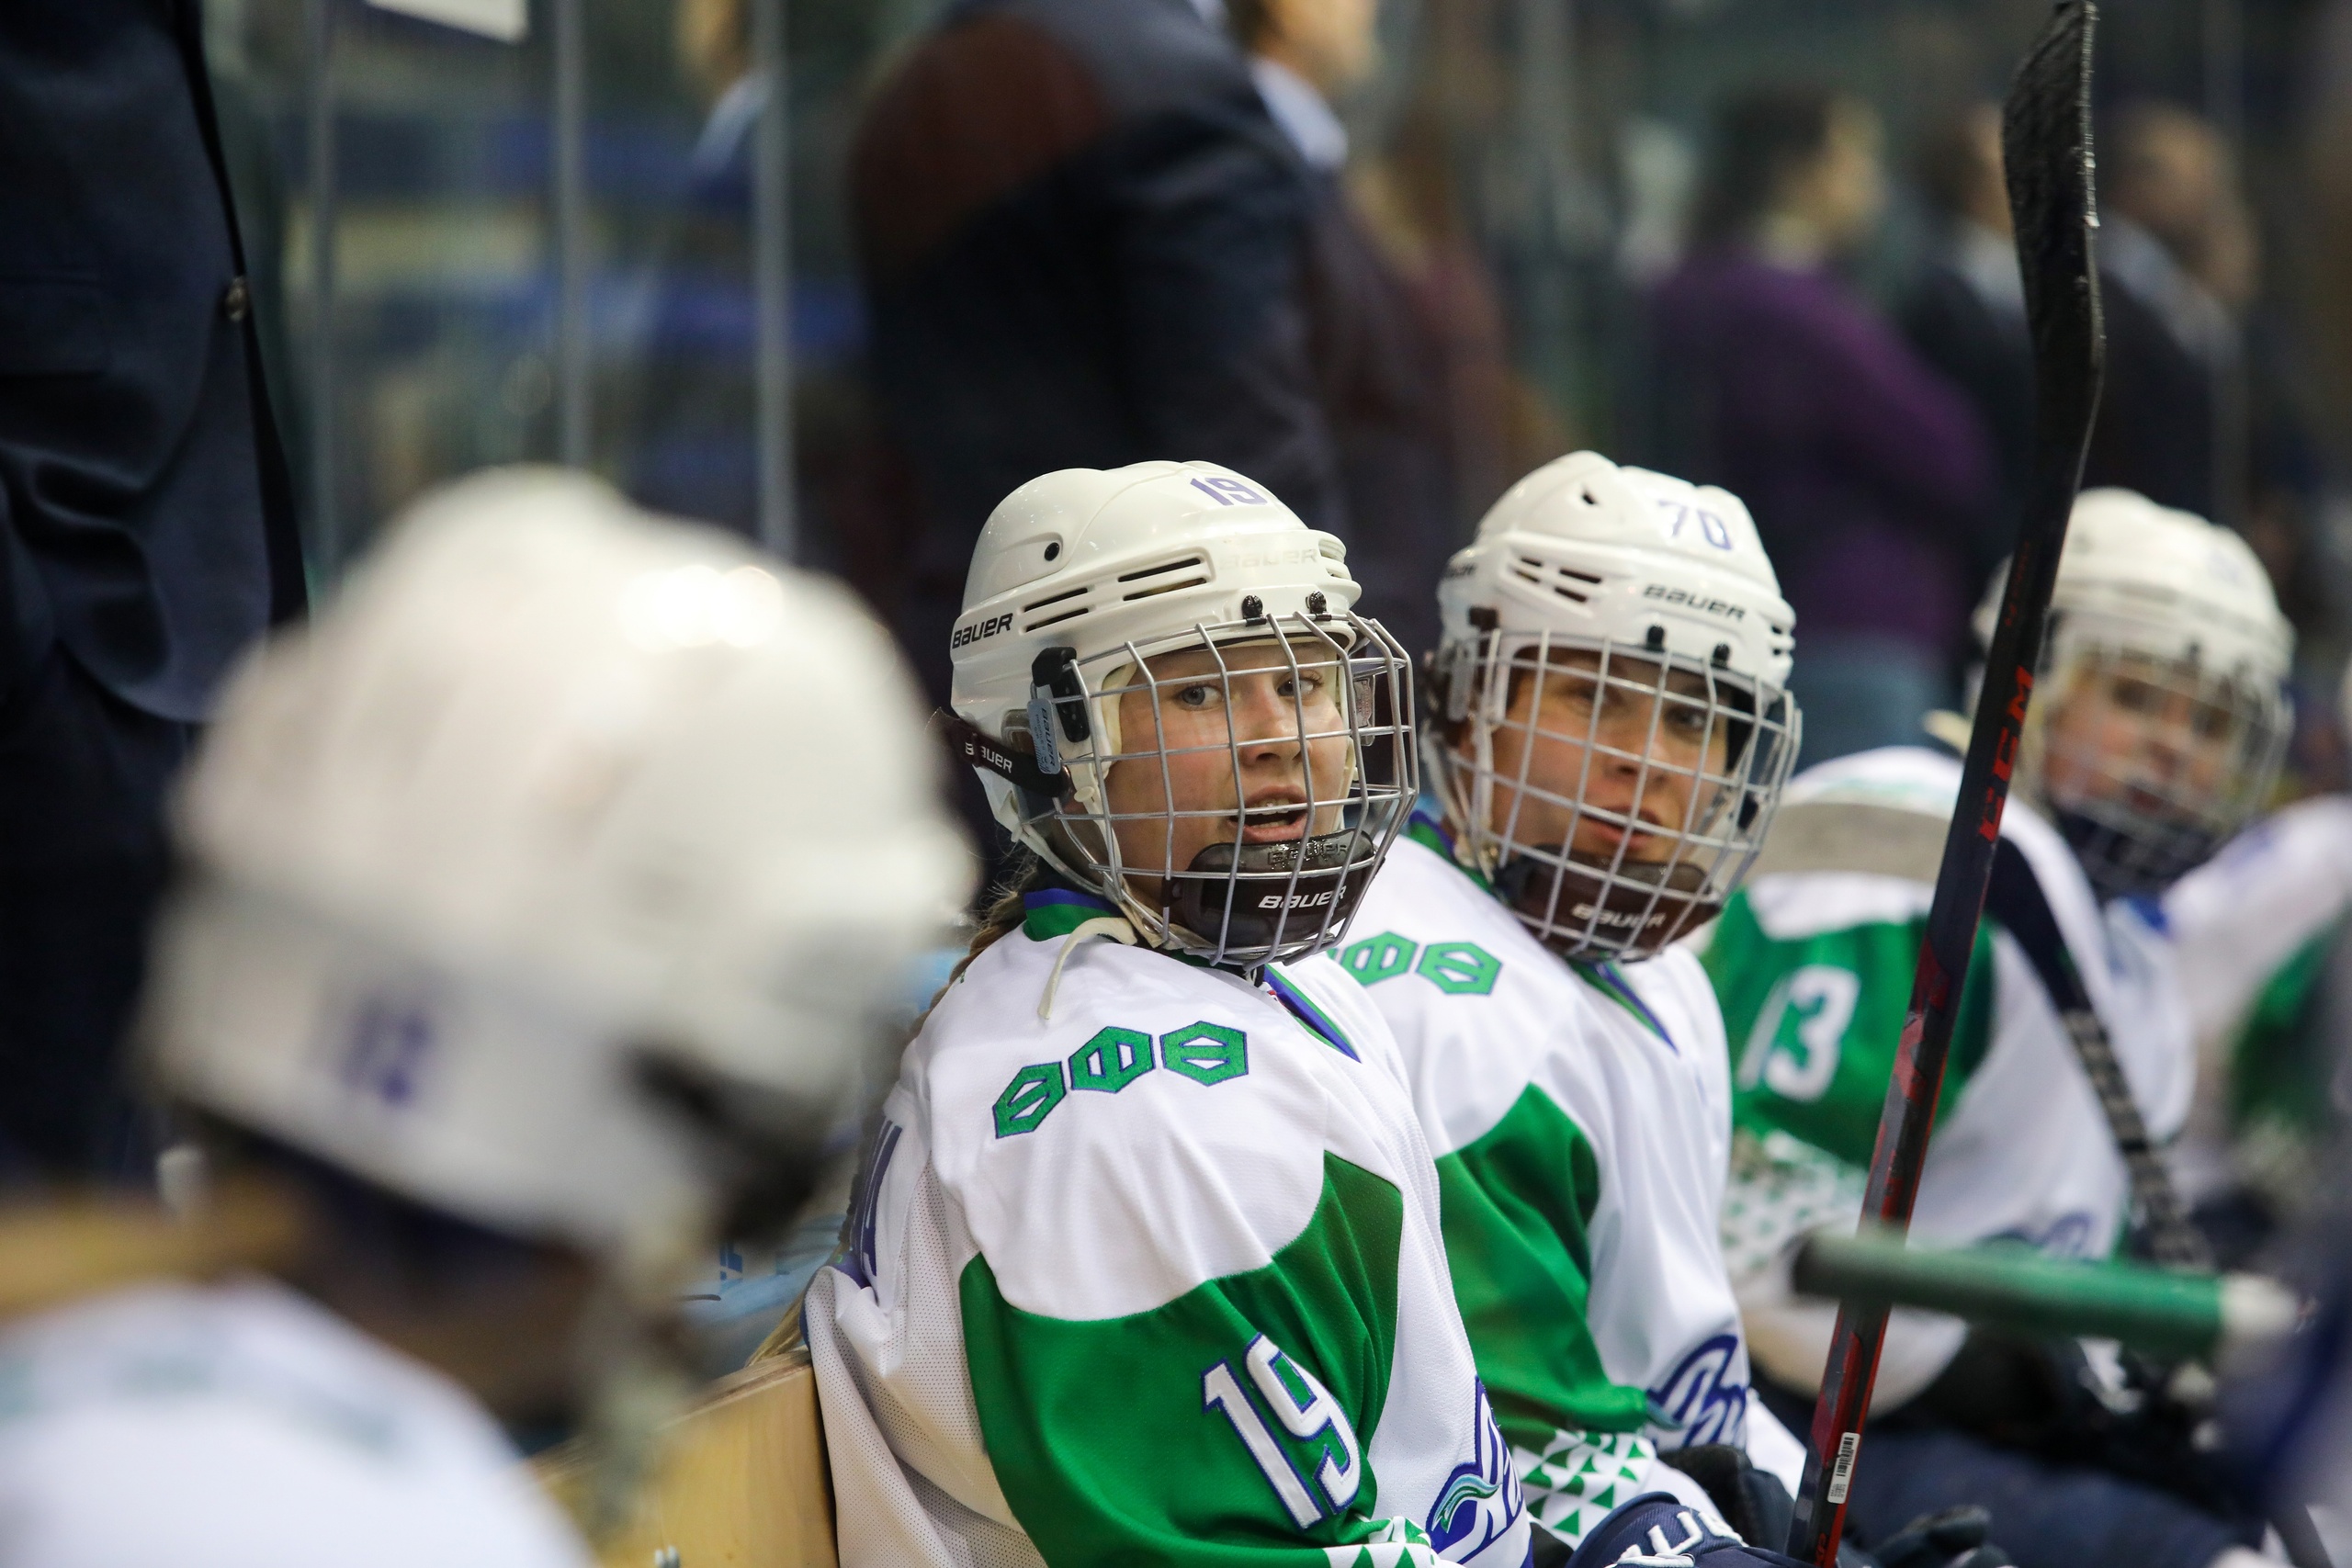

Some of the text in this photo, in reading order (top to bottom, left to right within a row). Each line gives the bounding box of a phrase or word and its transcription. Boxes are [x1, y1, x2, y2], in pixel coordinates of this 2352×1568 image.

[1191, 477, 1267, 505] 19
[1657, 499, 1734, 551] 70
[1643, 584, 1747, 622] BAUER
[952, 613, 1012, 649] BAUER
[1041, 707, 1056, 767] BAUER
[1200, 1332, 1361, 1529] 19
